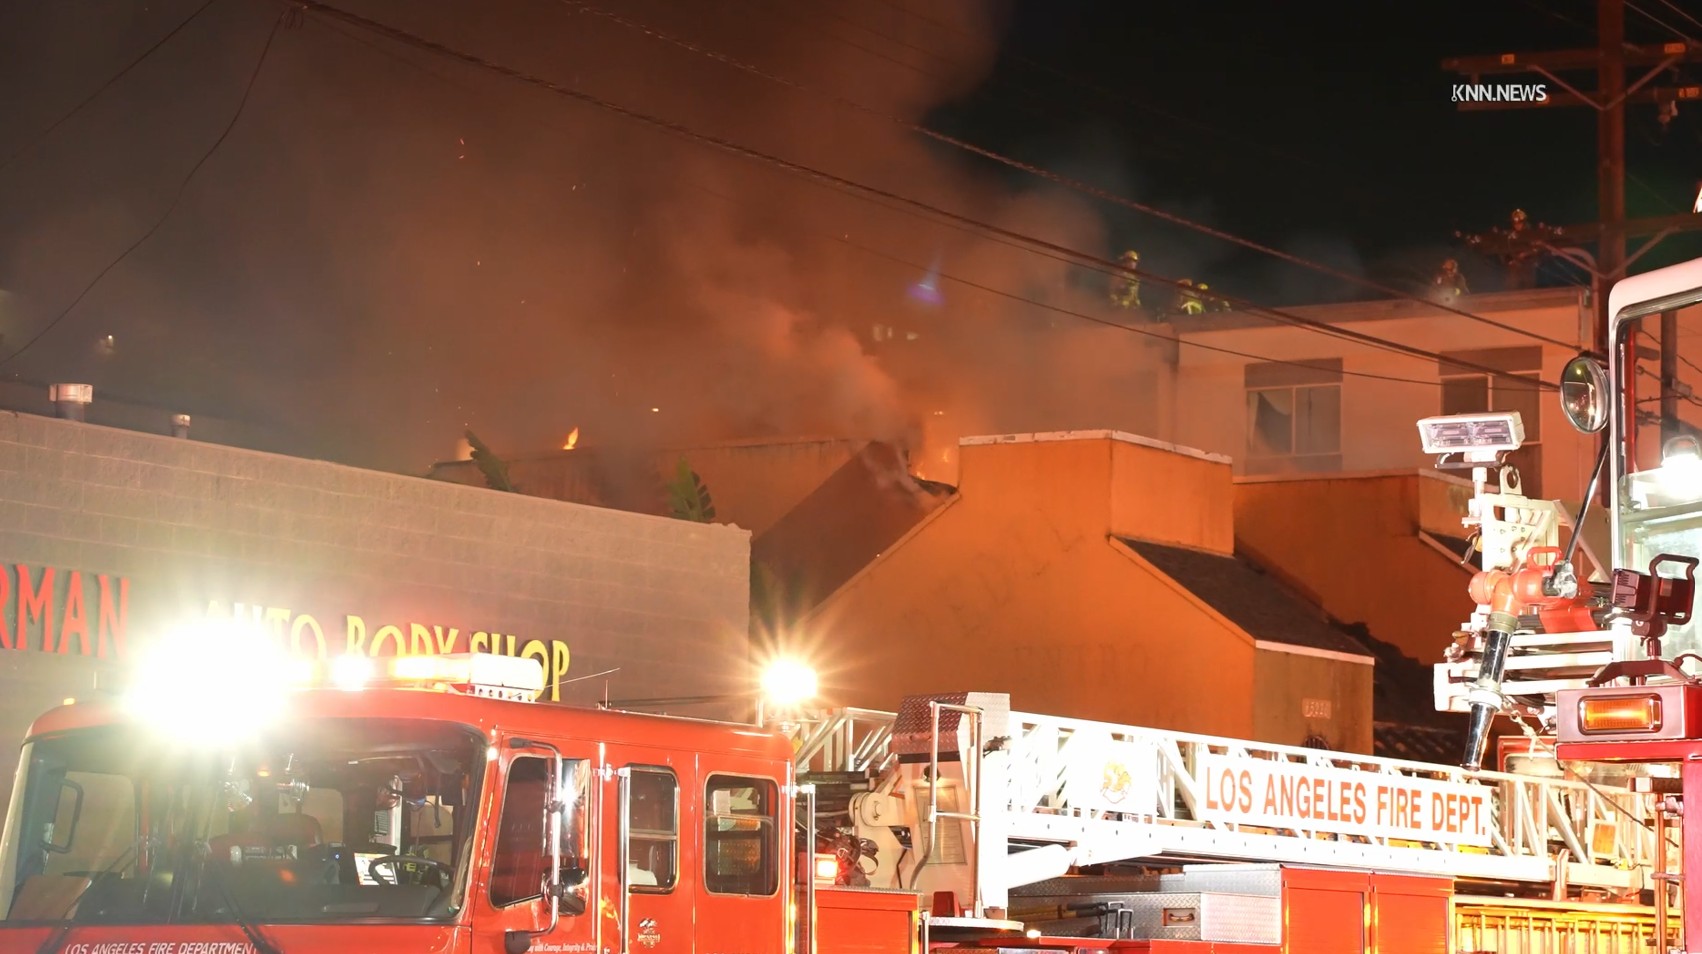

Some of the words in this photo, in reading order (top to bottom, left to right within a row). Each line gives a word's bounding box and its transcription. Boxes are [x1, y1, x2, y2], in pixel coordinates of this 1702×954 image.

[206, 600, 327, 672] TO
[1206, 766, 1252, 814] LOS
[1263, 773, 1366, 825] ANGELES
[1377, 785, 1422, 829] FIRE
[1432, 792, 1486, 836] DEPT.
[65, 943, 90, 954] LOS
[91, 943, 147, 954] ANGELES
[149, 942, 175, 954] FIRE
